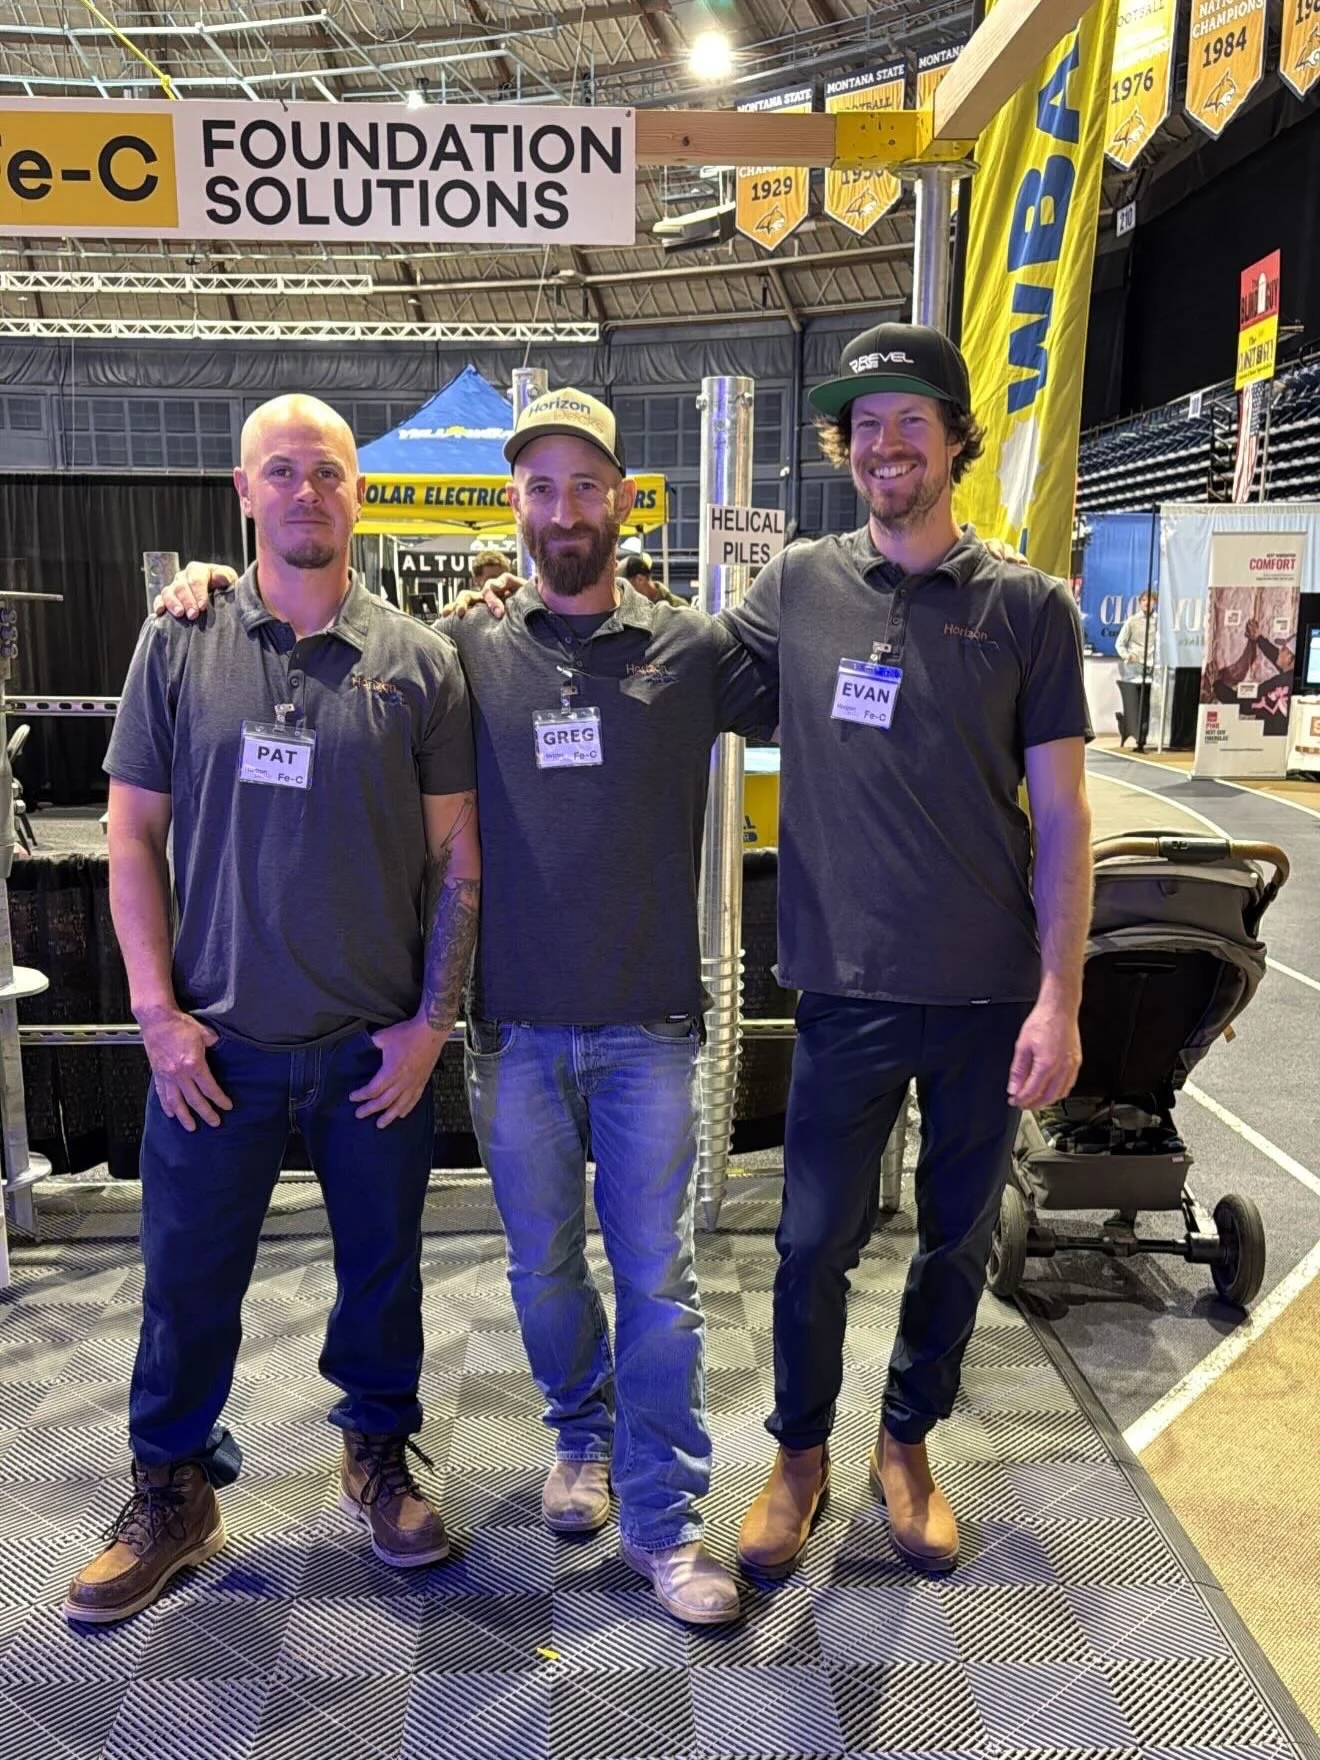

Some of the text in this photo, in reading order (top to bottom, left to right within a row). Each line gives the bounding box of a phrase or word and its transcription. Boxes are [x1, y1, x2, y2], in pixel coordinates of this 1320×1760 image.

[1193, 0, 1265, 38] CHAMPIONS
[1203, 26, 1247, 68] 1984
[827, 64, 905, 94] MONTANA STATE
[1111, 68, 1154, 104] 1976
[783, 88, 813, 105] STATE
[202, 119, 622, 174] FOUNDATION
[0, 134, 158, 202] e-C
[752, 176, 793, 201] 1929
[205, 175, 569, 230] SOLUTIONS
[528, 397, 591, 417] Horizon
[365, 484, 416, 505] OLAR
[711, 507, 783, 534] HELICAL
[723, 541, 770, 565] PILES
[1249, 558, 1296, 571] COMFORT
[944, 623, 988, 641] Horizon
[842, 682, 890, 703] EVAN
[864, 710, 886, 721] Fe-C
[543, 728, 594, 745] GREG
[257, 746, 297, 764] PAT
[574, 750, 597, 760] Fe-C
[278, 773, 303, 784] Fe-C
